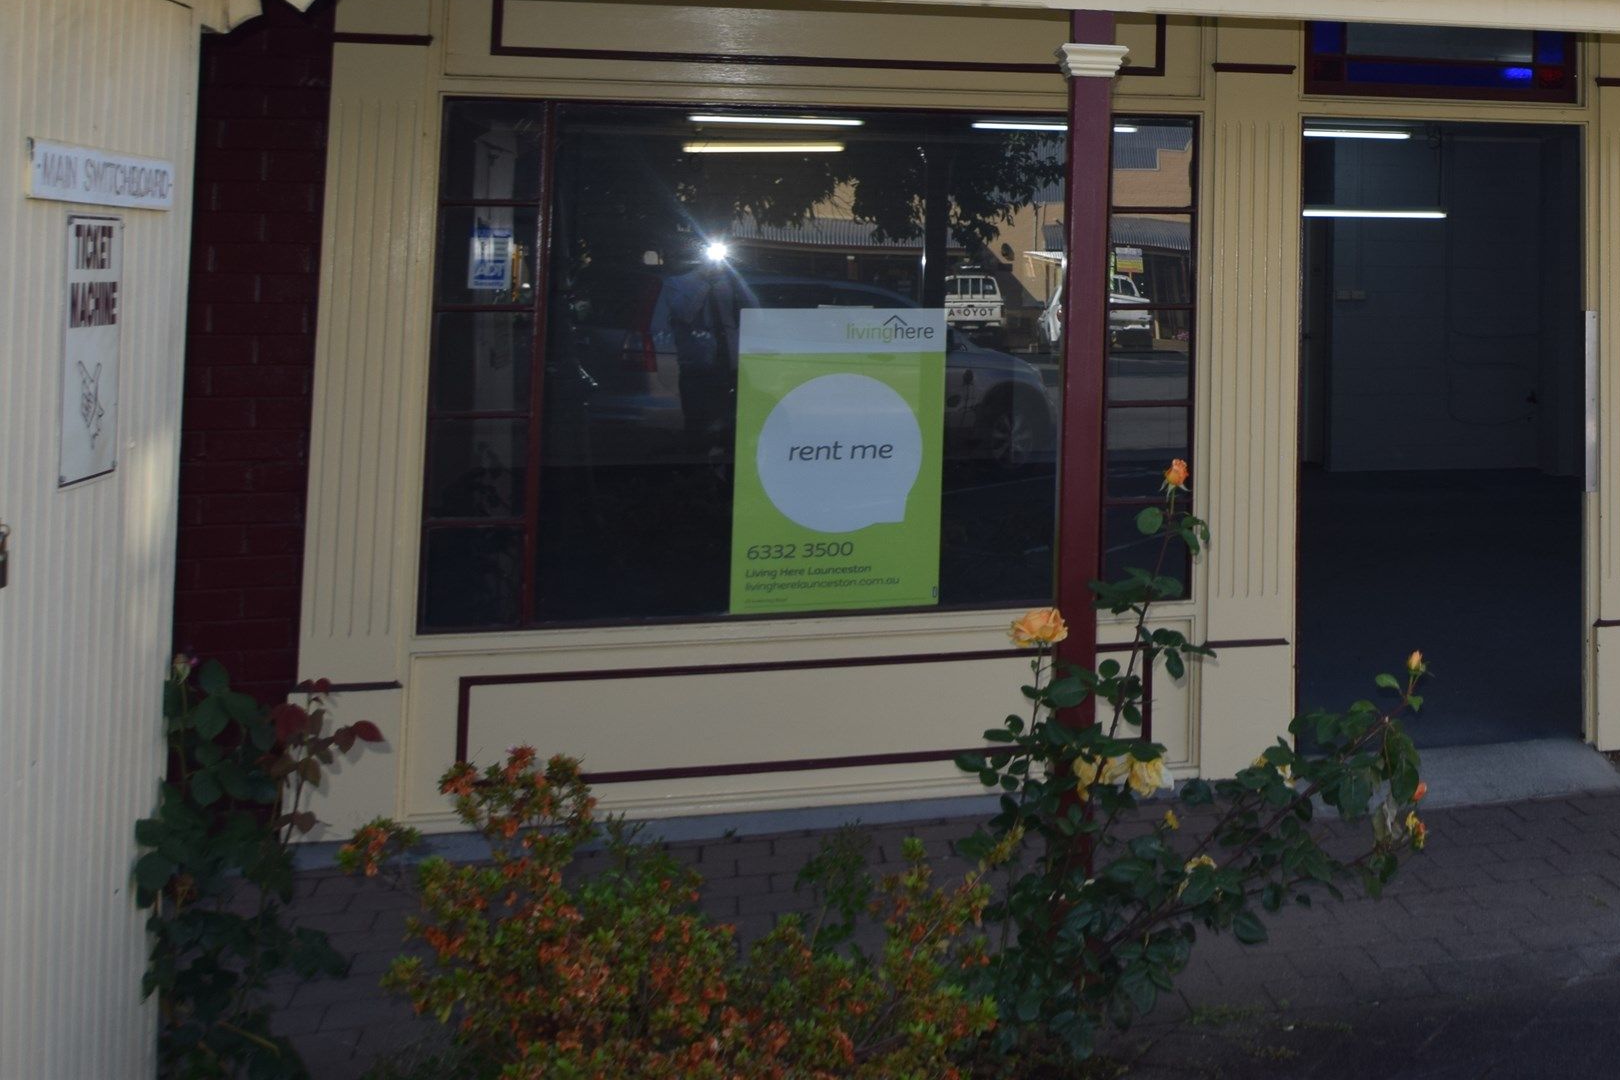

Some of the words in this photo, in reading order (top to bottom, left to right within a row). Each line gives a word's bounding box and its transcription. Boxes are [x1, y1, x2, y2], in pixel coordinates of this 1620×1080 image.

[41, 151, 78, 190] MAIN
[84, 157, 170, 200] SWITCHBOARD
[75, 224, 114, 270] TICKET
[70, 281, 118, 328] MACHINE
[846, 322, 935, 343] livinghere
[788, 440, 842, 461] rent
[850, 442, 894, 460] me
[747, 543, 797, 560] 6332
[803, 541, 854, 557] 3500
[745, 568, 778, 580] Living
[807, 564, 872, 576] Launceston
